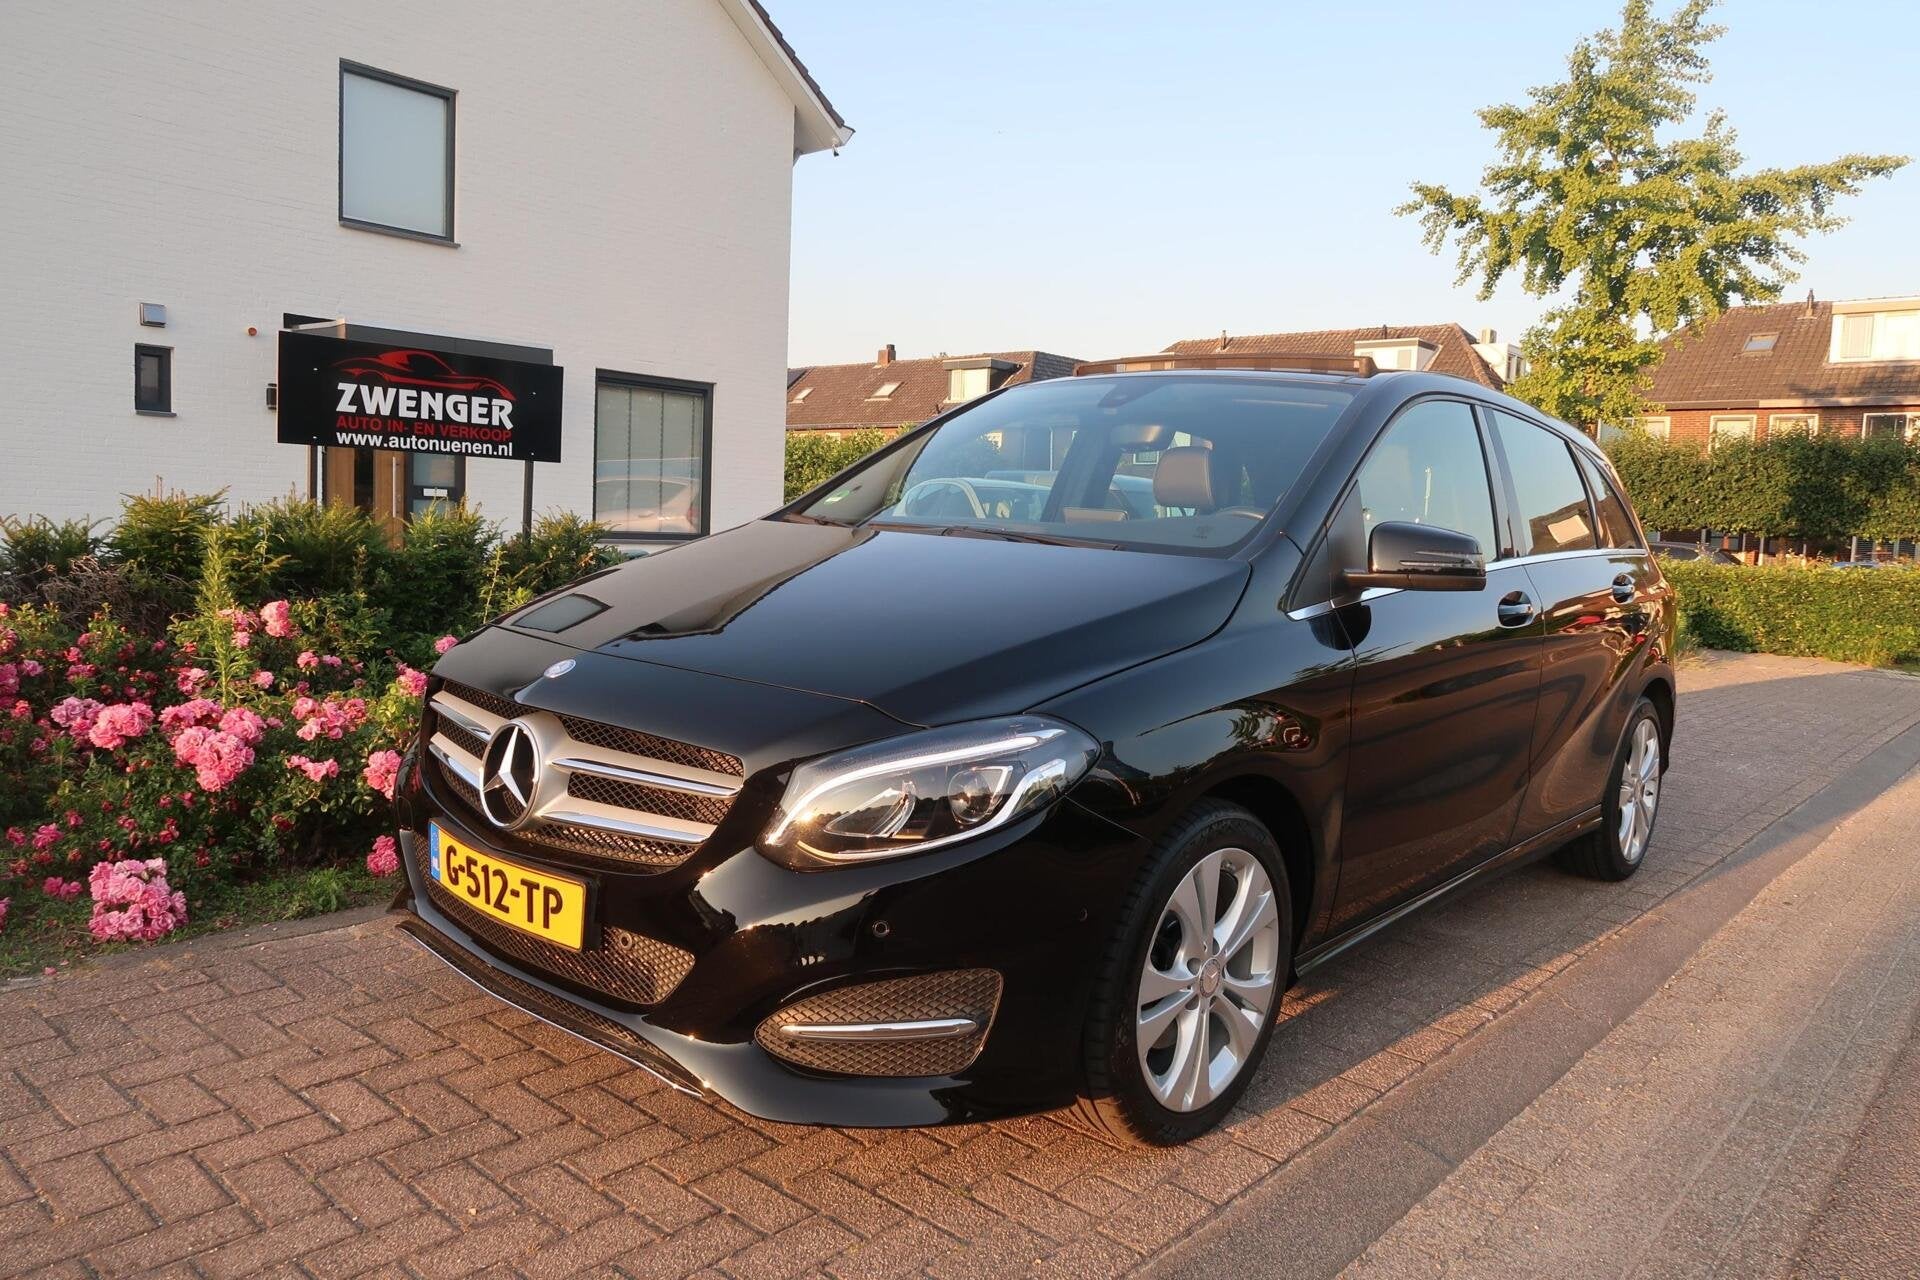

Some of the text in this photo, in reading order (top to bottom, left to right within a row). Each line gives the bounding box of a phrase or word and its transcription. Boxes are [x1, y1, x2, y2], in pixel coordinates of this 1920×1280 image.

[336, 382, 514, 430] ZWENGER
[336, 416, 512, 442] AUTO IN- EN VERKOOP
[336, 432, 513, 456] www.autonuenen.nl
[446, 845, 563, 929] G-512-TP
